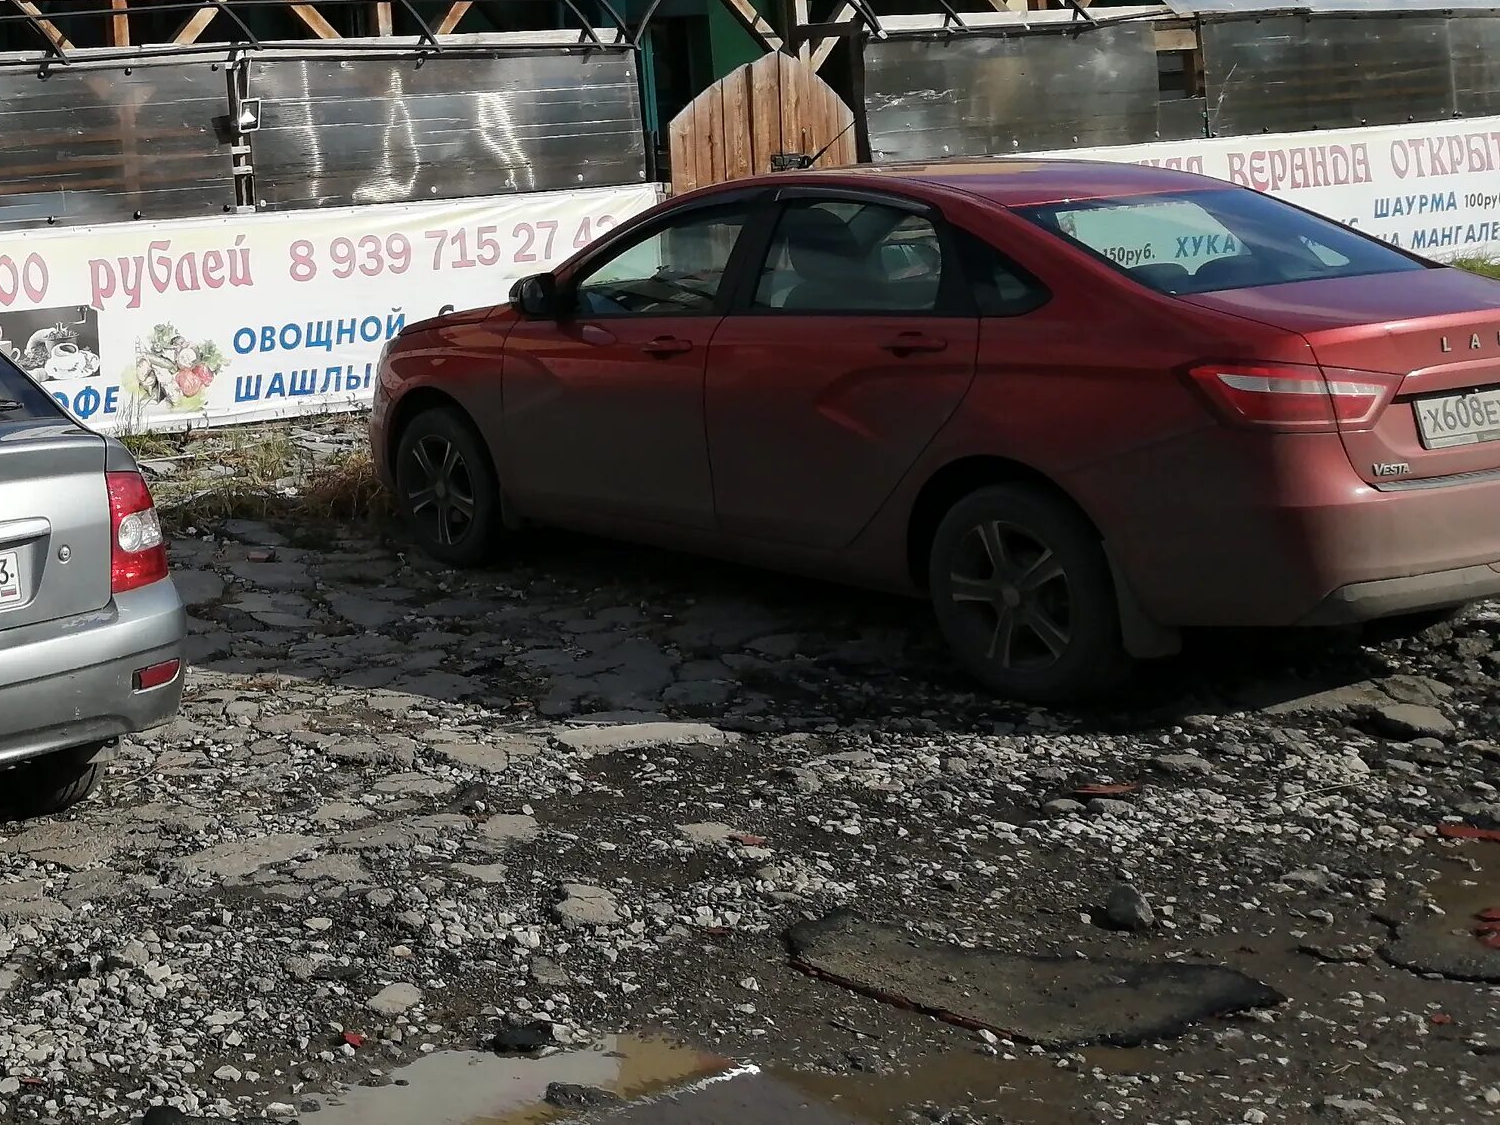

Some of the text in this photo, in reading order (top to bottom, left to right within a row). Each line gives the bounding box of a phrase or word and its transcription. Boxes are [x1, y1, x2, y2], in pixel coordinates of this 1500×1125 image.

[1226, 142, 1373, 194] ВЕРАНДА
[1373, 191, 1500, 219] ШАУРМА 100ру
[88, 234, 254, 312] рублей
[289, 239, 318, 283] 8
[329, 232, 412, 279] 939
[424, 225, 501, 271] 715
[512, 220, 559, 264] 27
[233, 306, 406, 355] ОВОЩНОЙ
[1441, 329, 1500, 353] LA
[1426, 394, 1500, 434] Х608Е
